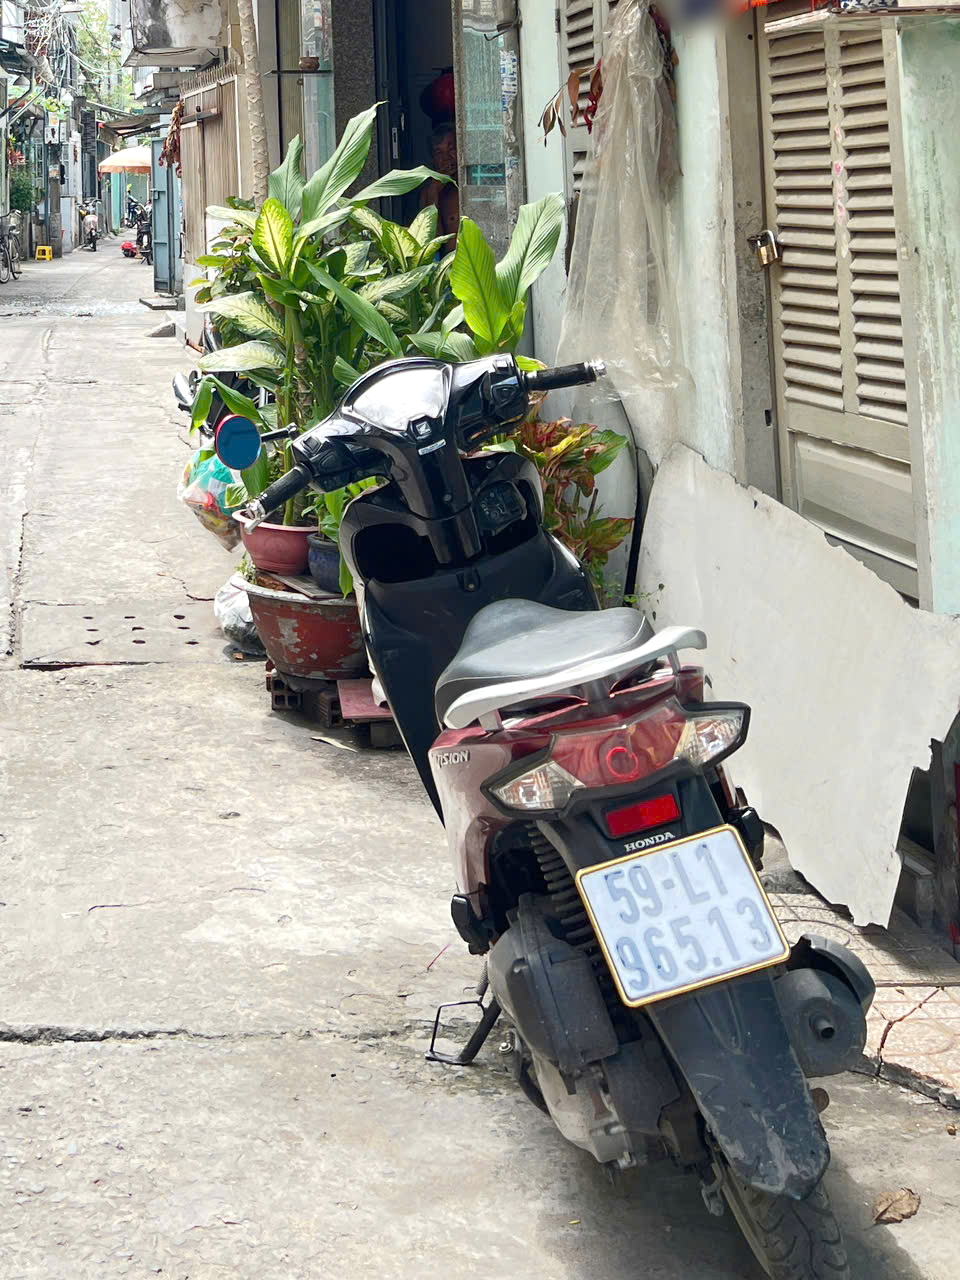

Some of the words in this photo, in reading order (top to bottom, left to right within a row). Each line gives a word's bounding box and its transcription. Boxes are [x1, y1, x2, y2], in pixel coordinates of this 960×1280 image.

[624, 831, 675, 852] HONDA
[604, 844, 728, 924] 59-L1
[617, 897, 774, 991] 965.13
